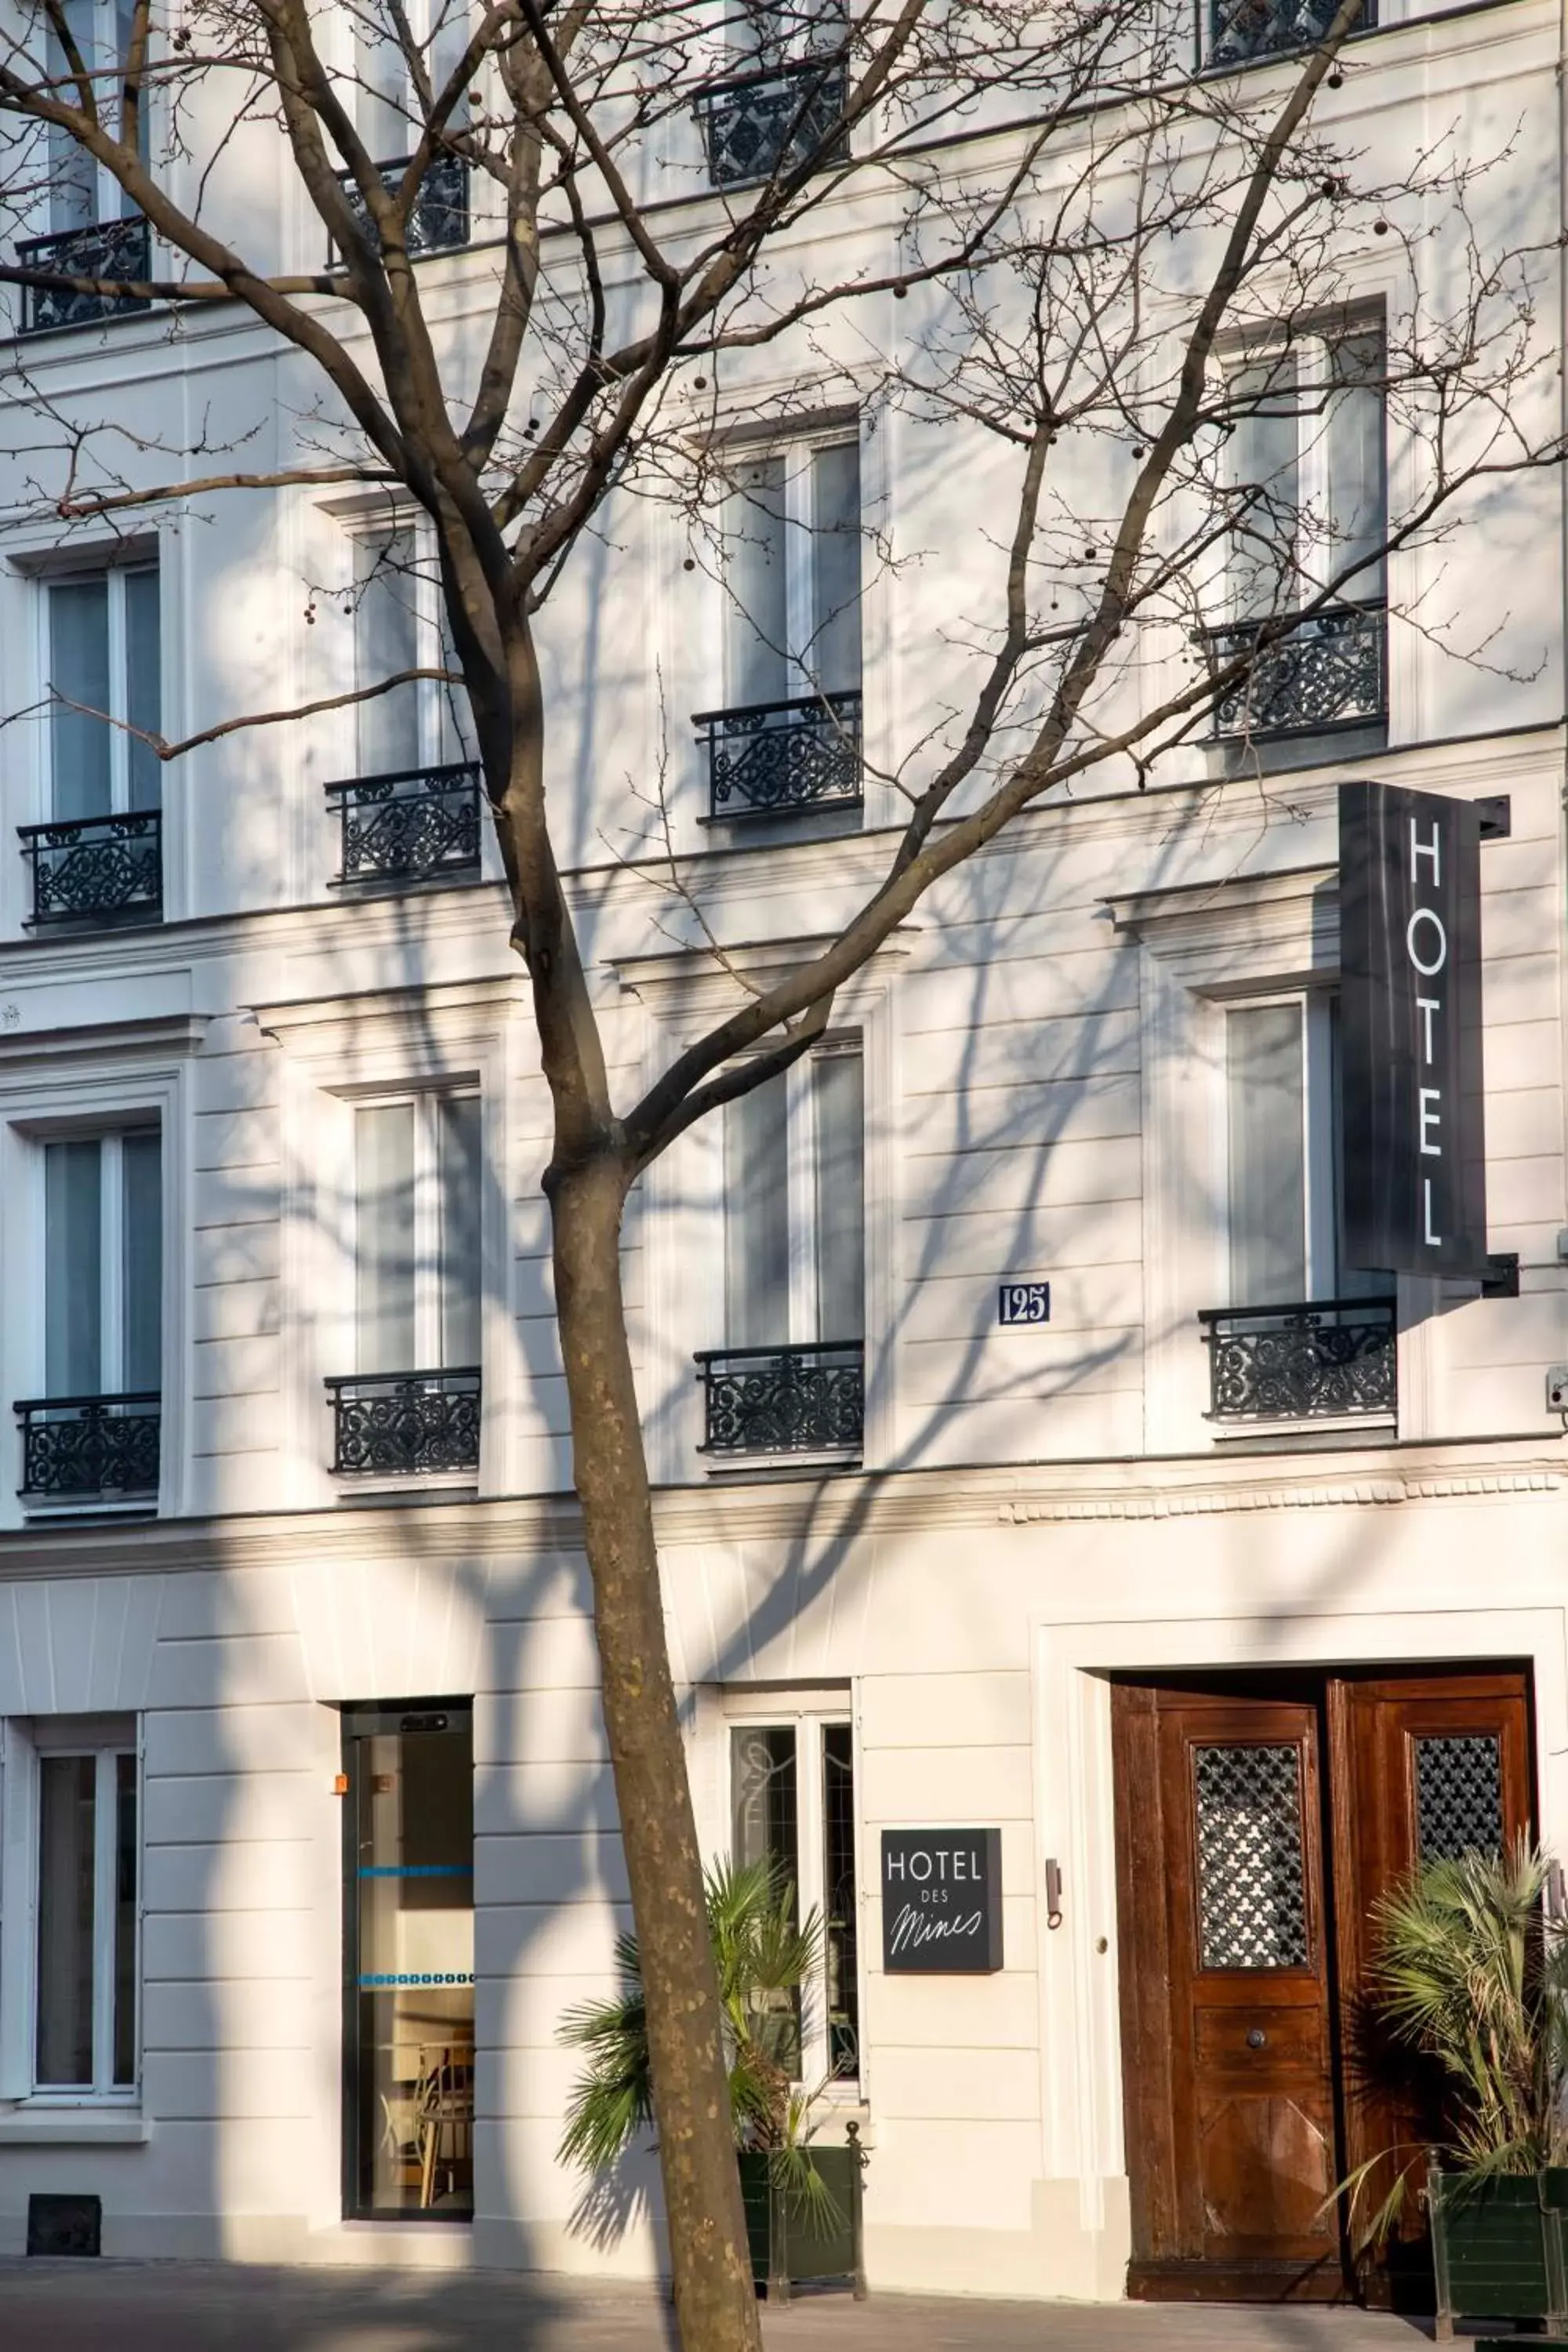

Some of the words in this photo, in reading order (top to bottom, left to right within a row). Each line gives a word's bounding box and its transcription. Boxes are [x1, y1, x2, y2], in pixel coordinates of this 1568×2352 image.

[1406, 818, 1446, 1247] HOTEL
[1004, 1287, 1045, 1321] 125
[887, 1851, 982, 1881] HOTEL
[921, 1889, 948, 1903] DES
[890, 1903, 982, 1955] Mines
